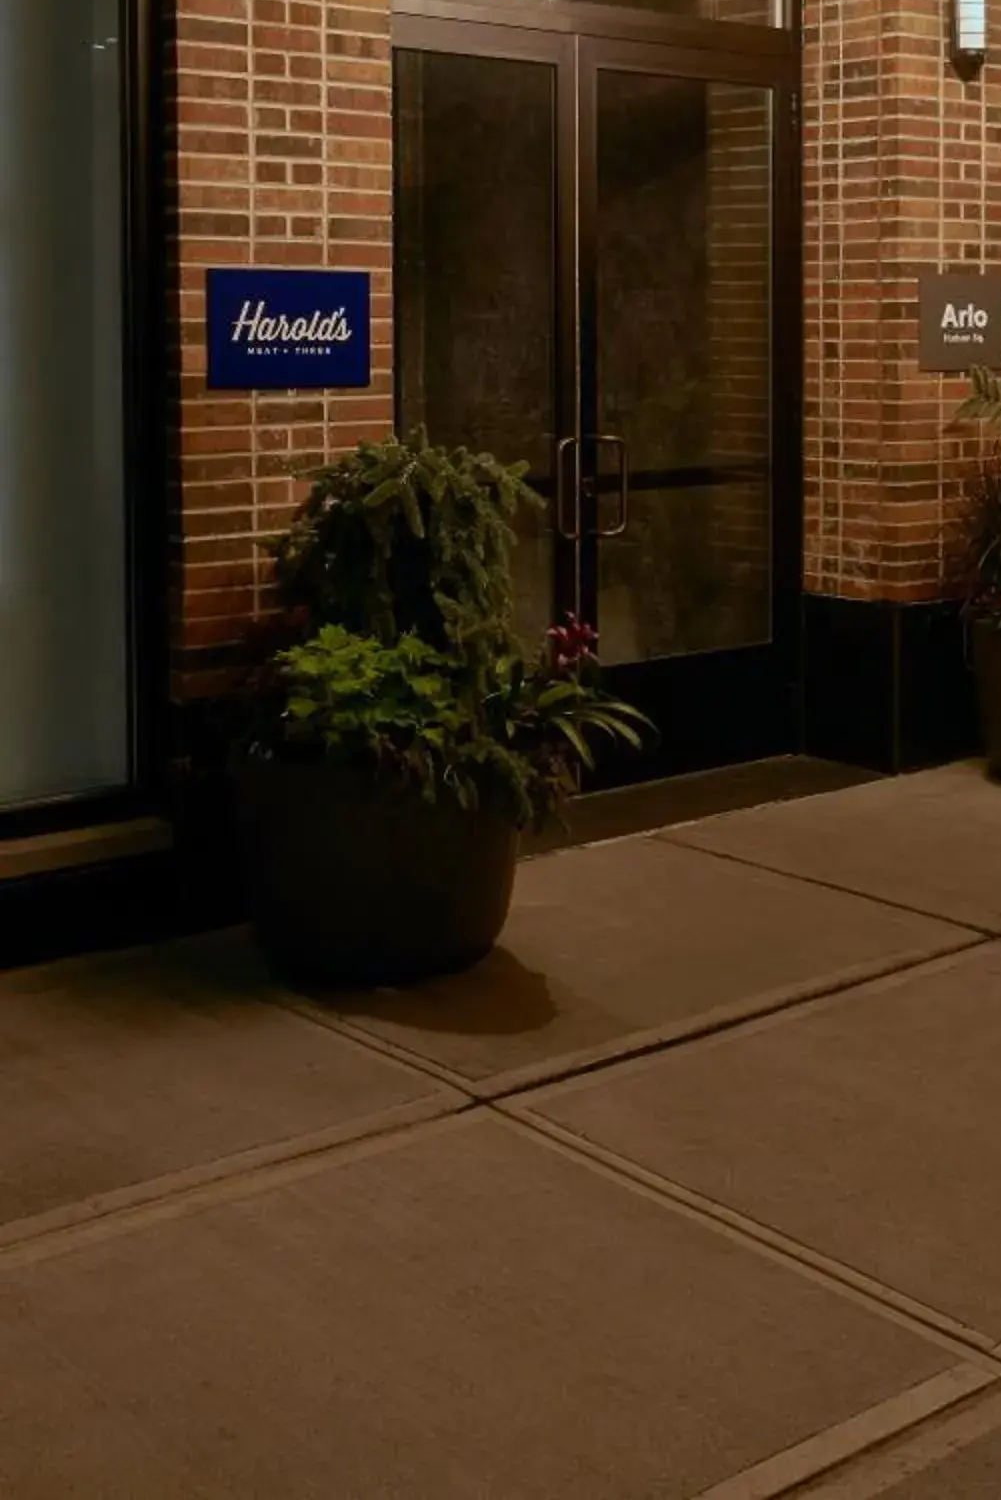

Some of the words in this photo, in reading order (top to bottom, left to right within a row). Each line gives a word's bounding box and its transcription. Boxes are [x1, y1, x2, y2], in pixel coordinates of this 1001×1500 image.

[230, 300, 352, 342] Harold's
[940, 303, 988, 328] Arlo
[246, 347, 278, 355] MEAT
